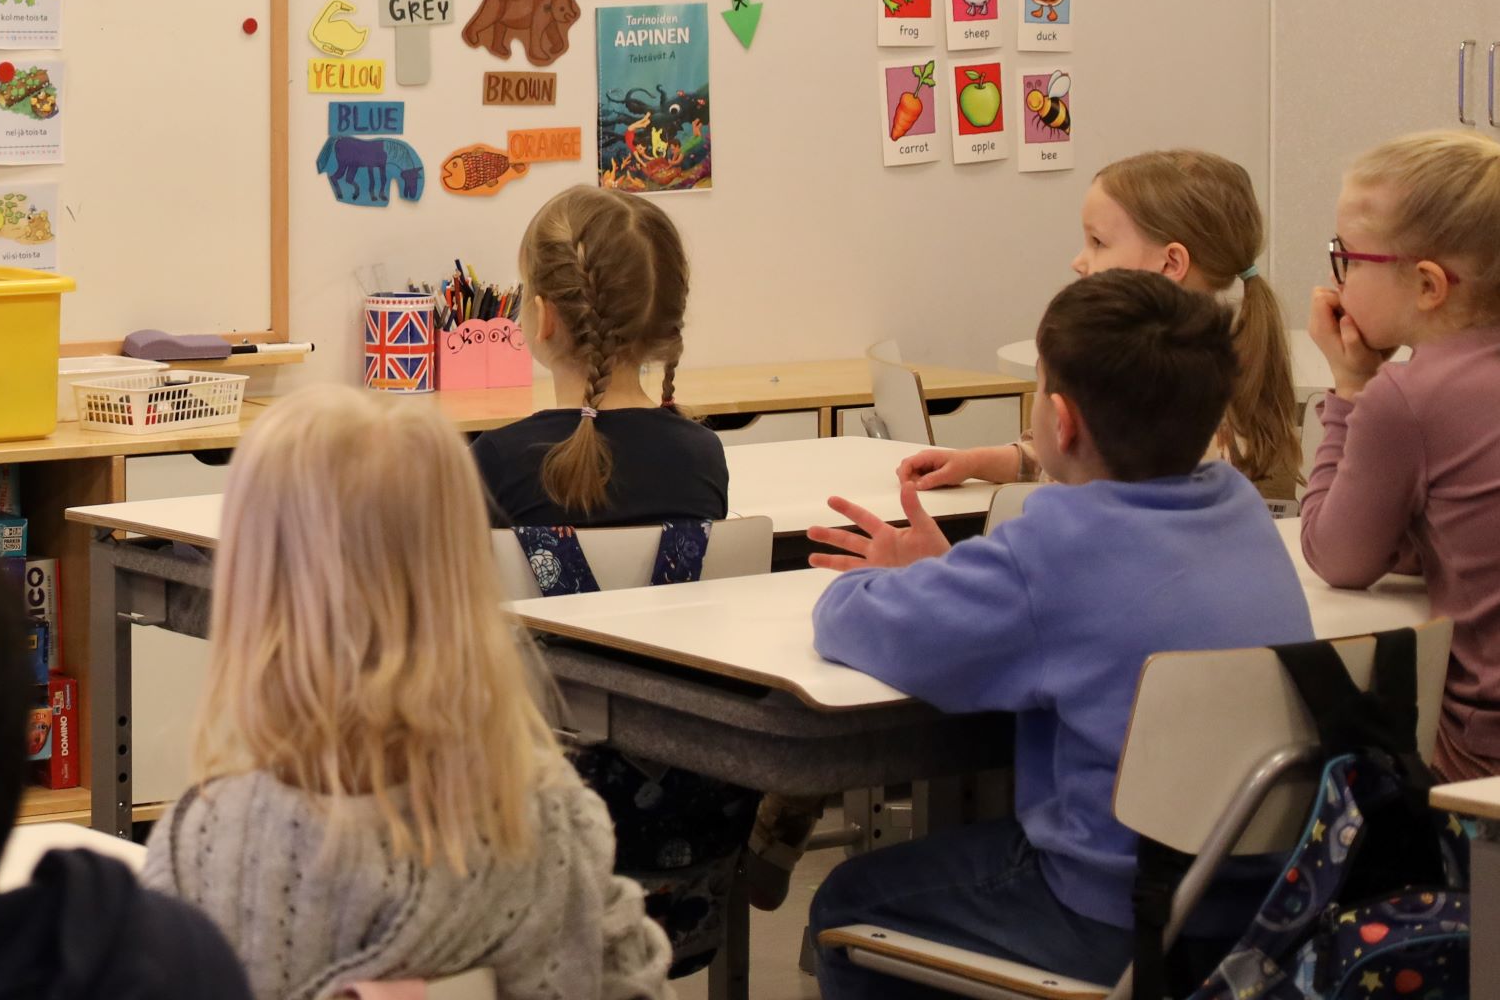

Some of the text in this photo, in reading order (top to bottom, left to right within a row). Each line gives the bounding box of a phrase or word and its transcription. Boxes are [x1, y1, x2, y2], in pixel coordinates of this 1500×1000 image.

[626, 14, 678, 26] Tarinoiden
[614, 27, 690, 47] AAPINEN
[899, 25, 919, 39] frog
[964, 29, 990, 41] sheep
[1036, 32, 1057, 41] duck
[313, 63, 382, 89] YELLOW
[487, 75, 554, 102] BROWN
[337, 104, 398, 131] BLUE
[510, 132, 581, 159] ORANGE
[899, 143, 929, 154] carrot
[971, 141, 995, 155] apple
[1041, 151, 1057, 160] bee
[60, 715, 69, 757] DOMINO
